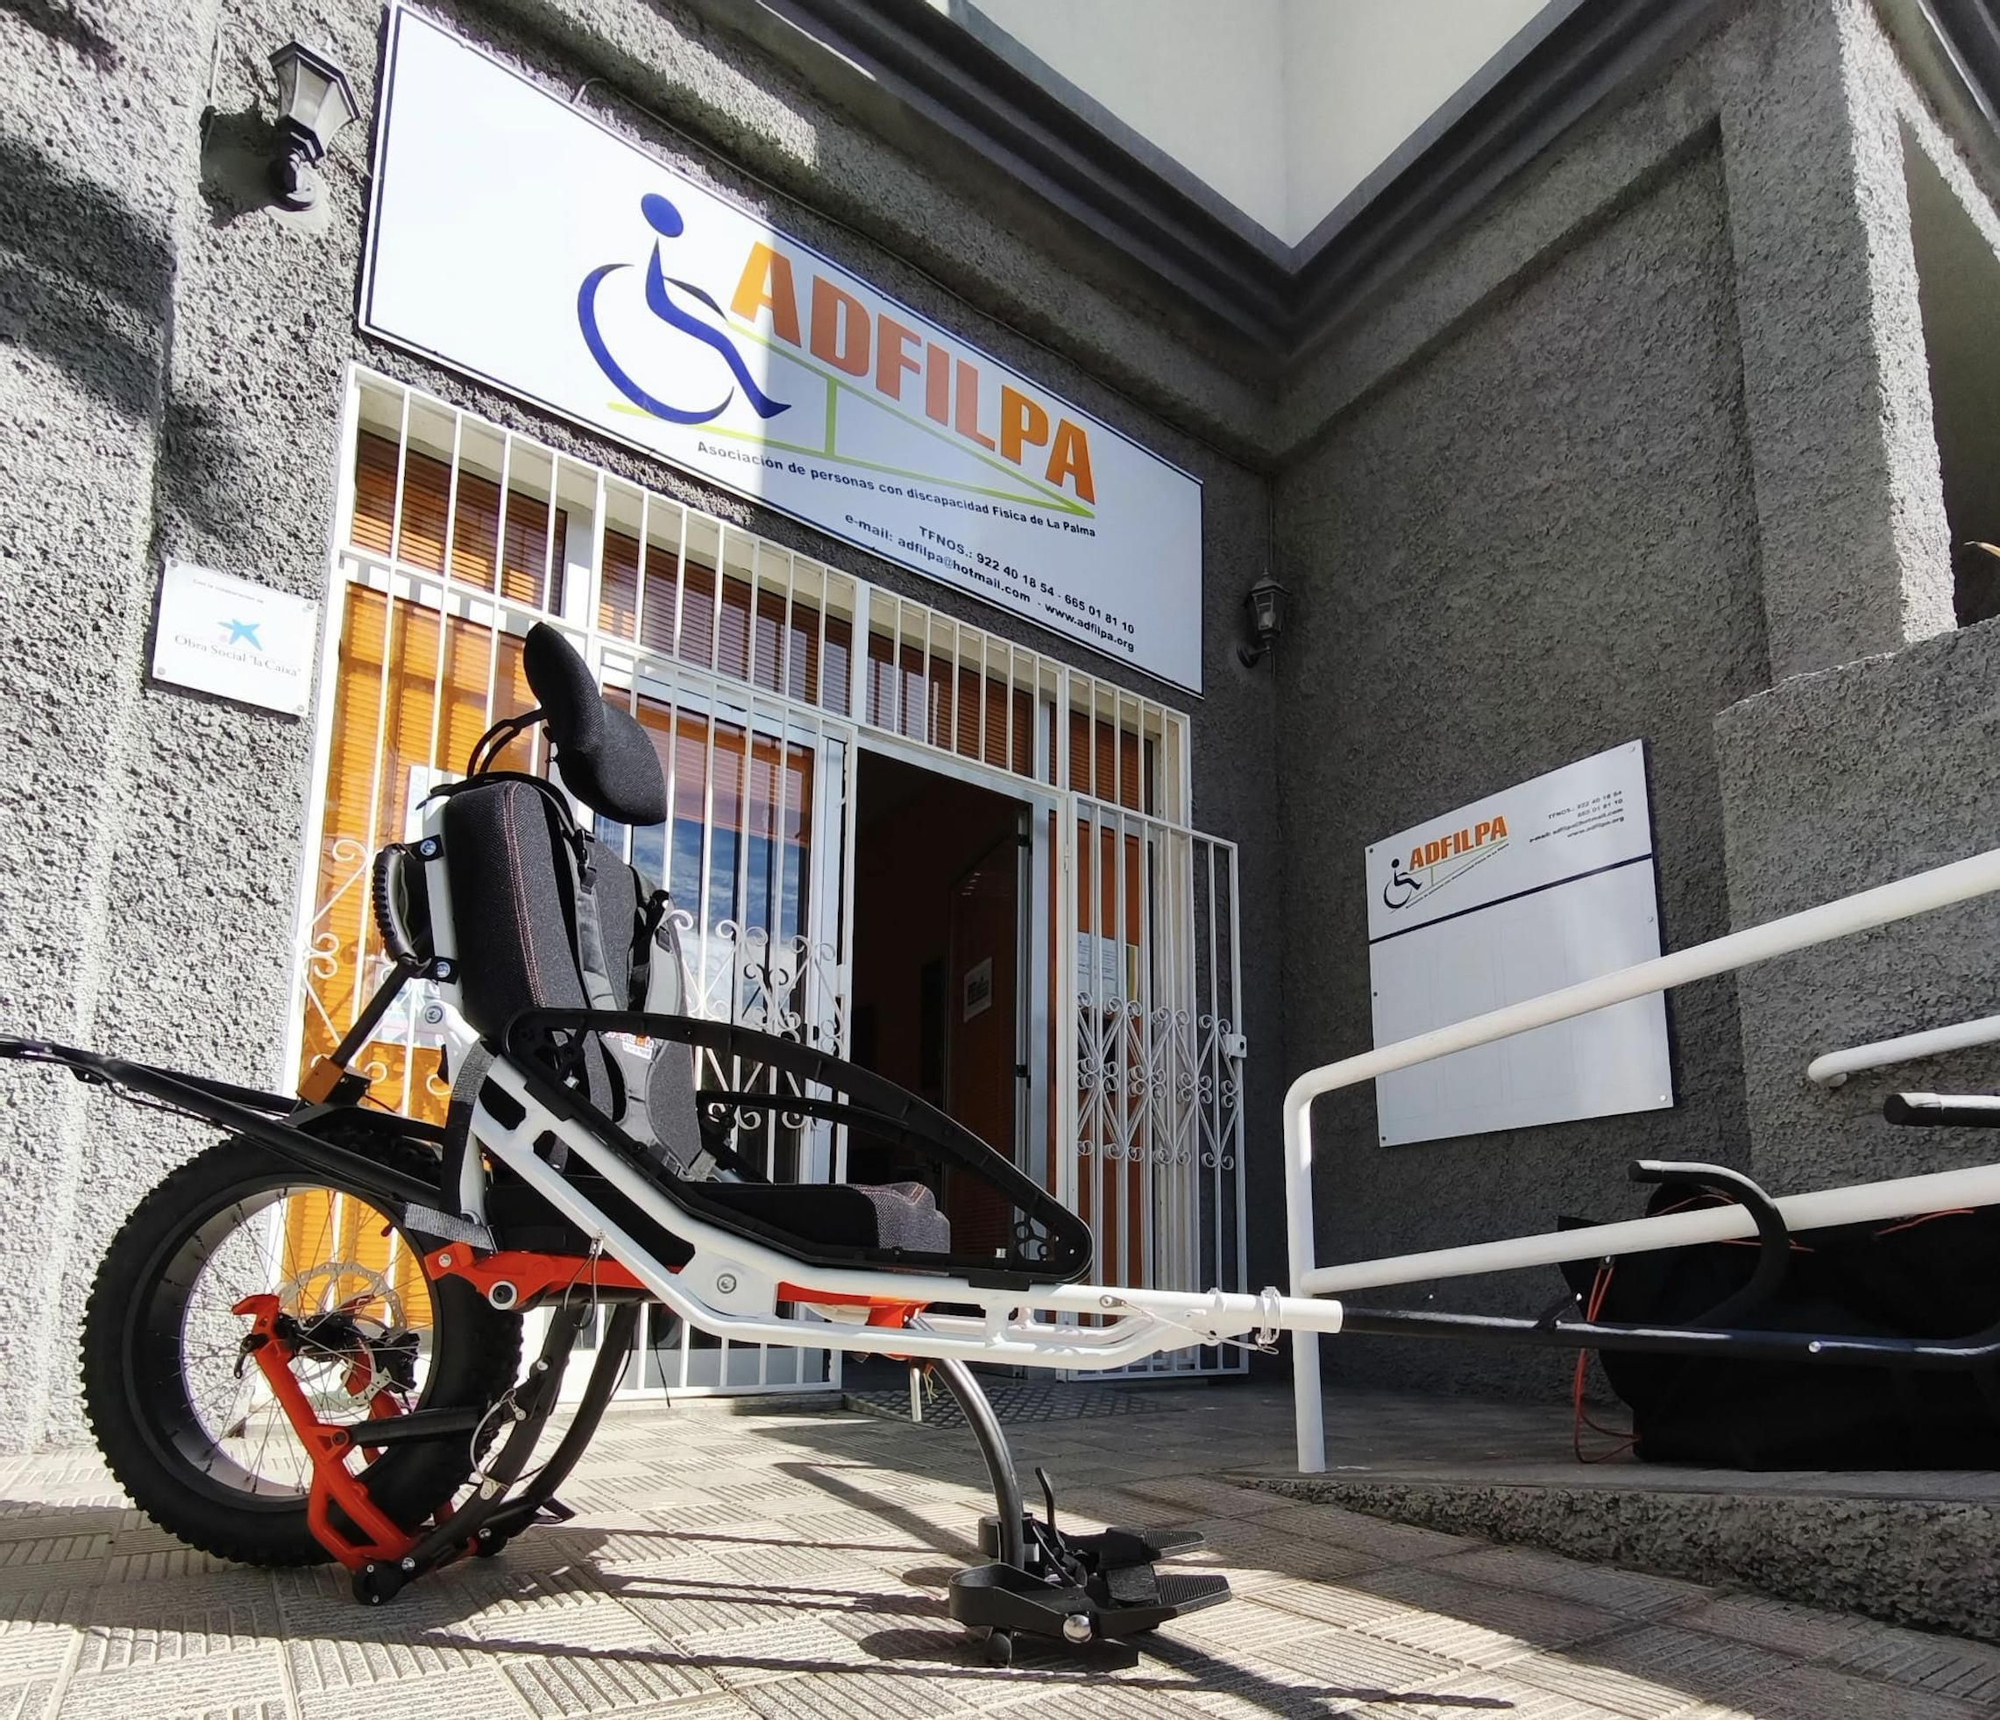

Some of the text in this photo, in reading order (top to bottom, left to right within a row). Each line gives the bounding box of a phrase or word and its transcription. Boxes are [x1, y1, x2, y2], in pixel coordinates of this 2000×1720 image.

[730, 241, 1096, 505] ADFILPA
[697, 441, 784, 471] Asociación
[788, 462, 806, 475] de
[810, 468, 875, 490] personas
[879, 483, 903, 496] con
[906, 488, 989, 514] discapacidad
[1030, 515, 1044, 526] de
[1047, 518, 1060, 530] La
[1063, 521, 1096, 537] Palma
[845, 513, 893, 542] e-mail:
[897, 537, 1031, 603] adfilpa@hotmail.com
[1044, 603, 1135, 653] www.adfilpa.org
[919, 525, 973, 559] TFNOS.:
[976, 552, 1000, 571] 922
[1003, 566, 1019, 580] 40
[1023, 575, 1037, 588] 18
[1040, 582, 1055, 597] 54
[1064, 594, 1085, 611] 665
[1088, 605, 1101, 618] 01
[1105, 613, 1117, 626] 81
[1122, 621, 1135, 634] 10
[174, 634, 208, 652] Obra
[210, 643, 247, 663] Social
[1409, 815, 1508, 872] ADFILPA
